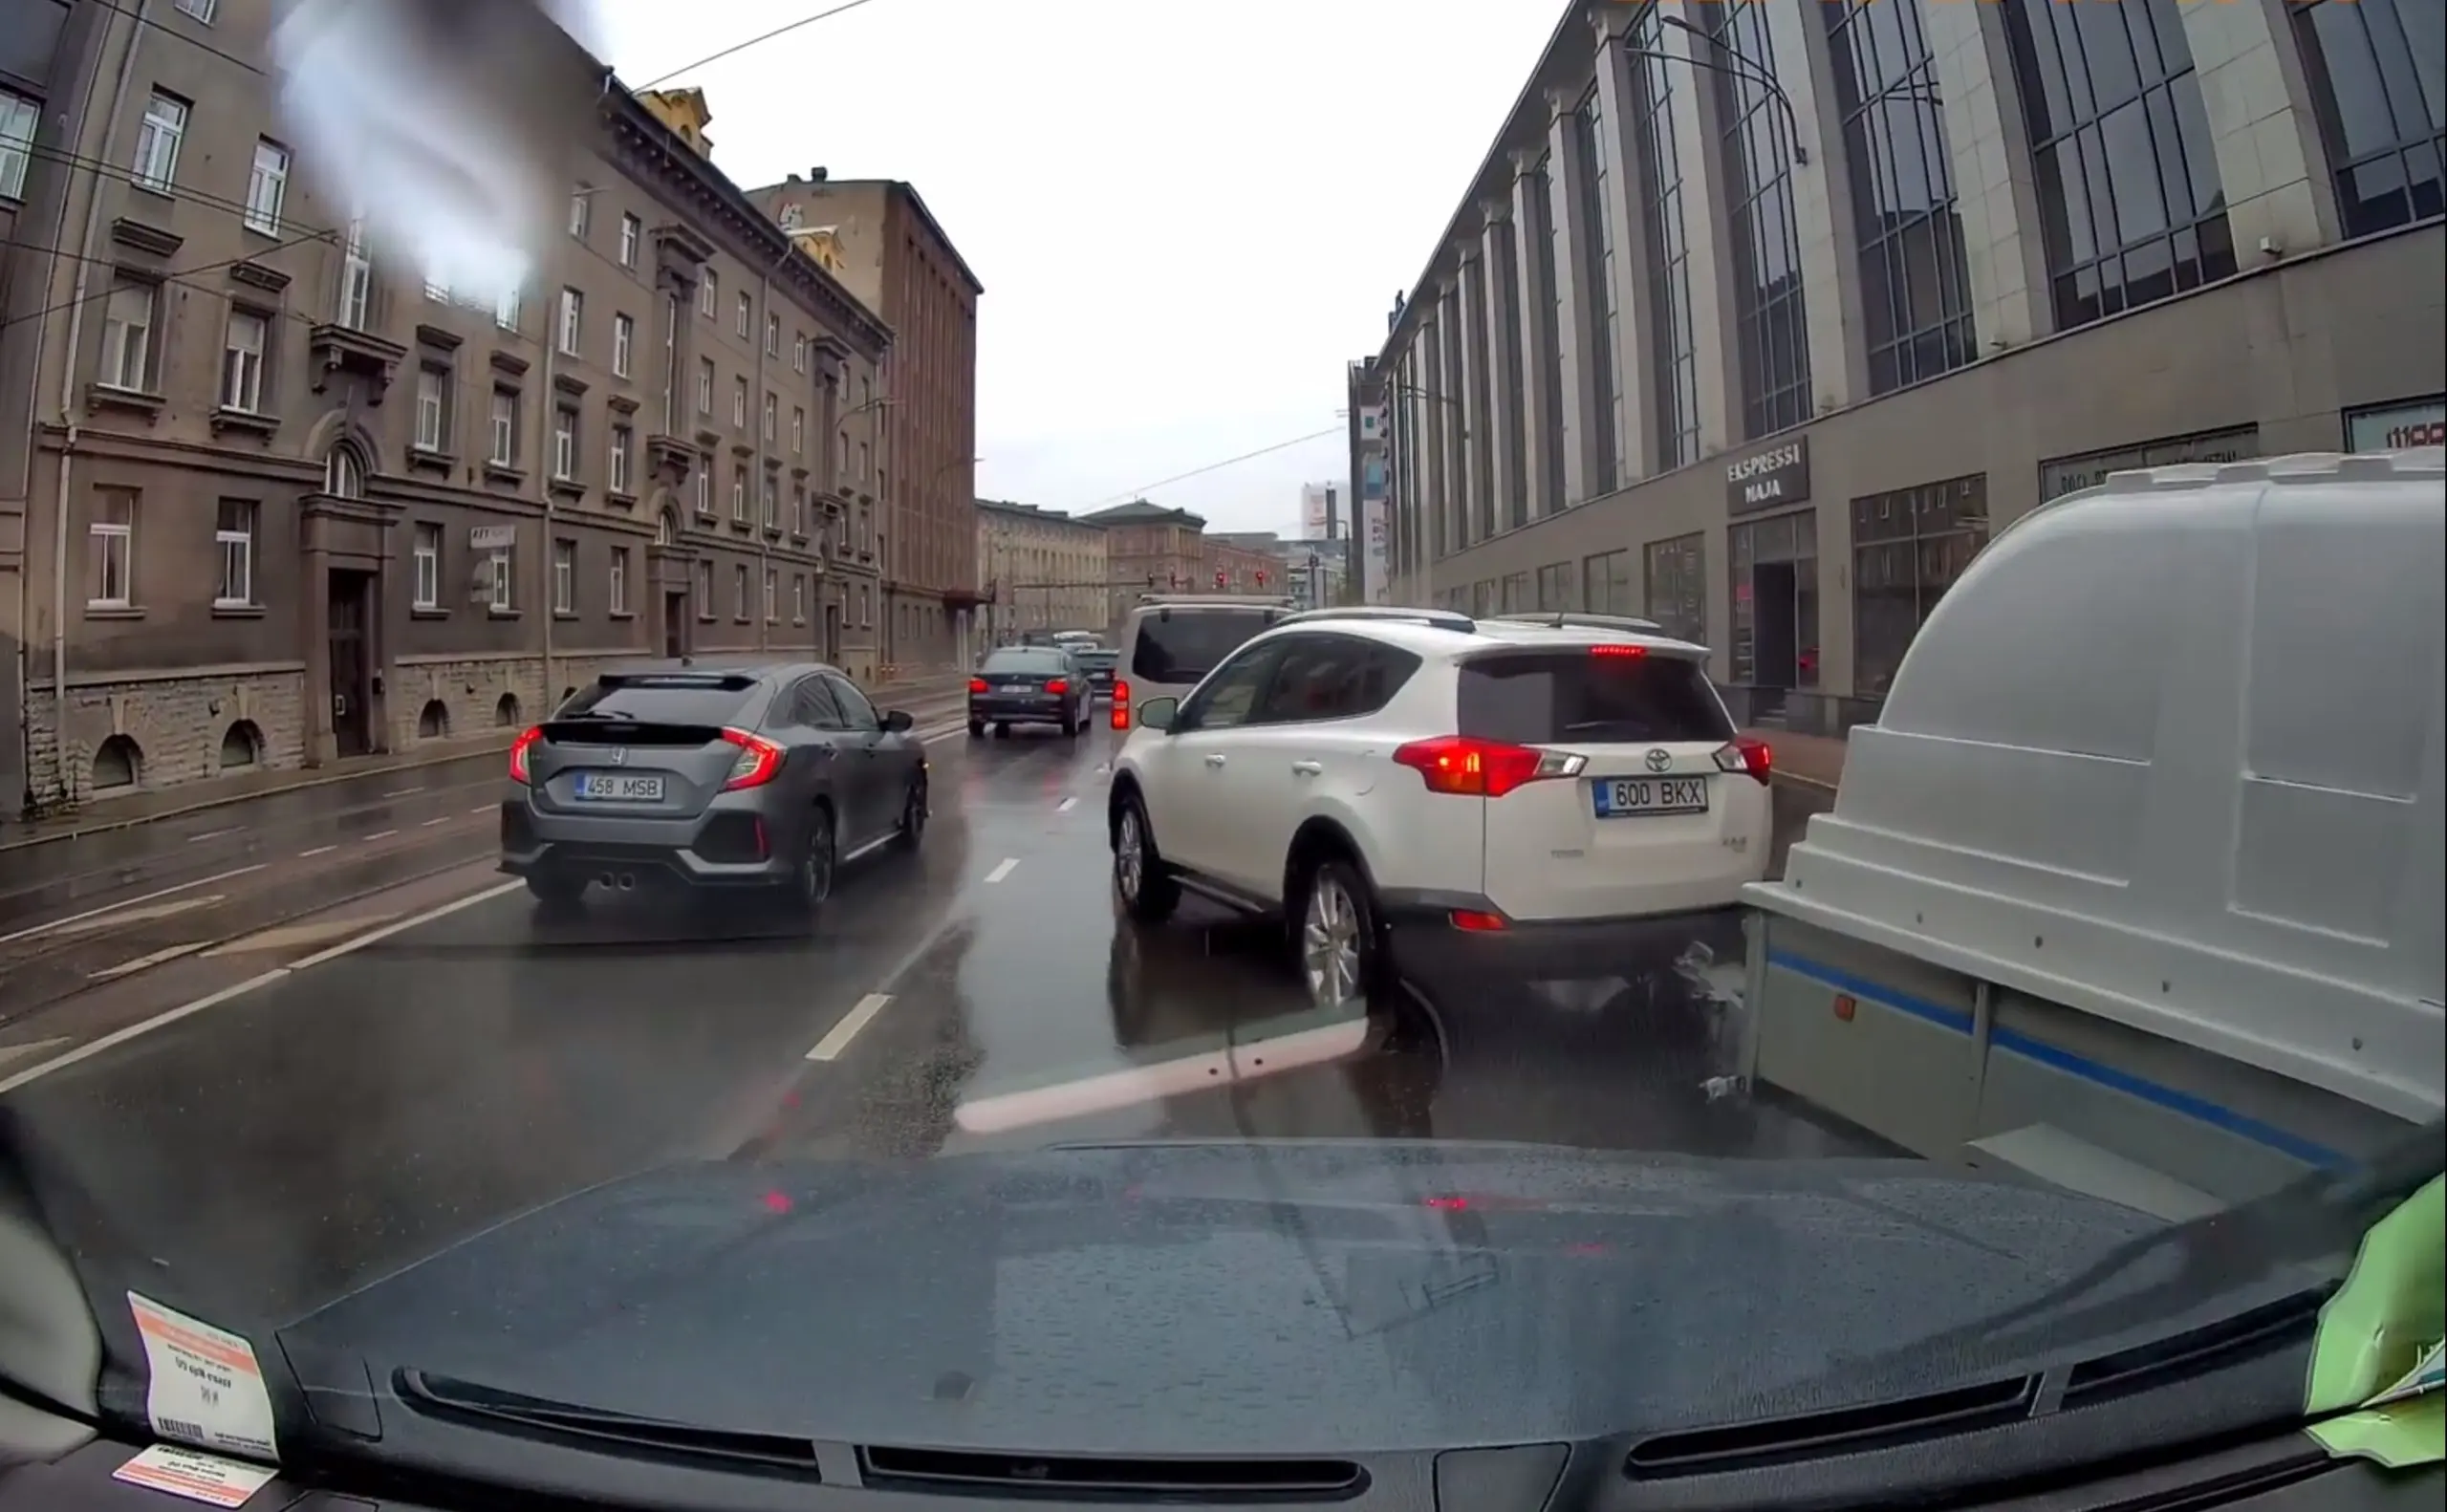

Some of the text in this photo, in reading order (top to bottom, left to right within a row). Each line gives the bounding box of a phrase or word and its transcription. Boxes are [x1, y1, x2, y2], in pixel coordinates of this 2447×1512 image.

[588, 778, 658, 795] 458 MSB
[1616, 781, 1700, 806] 600 BKX
